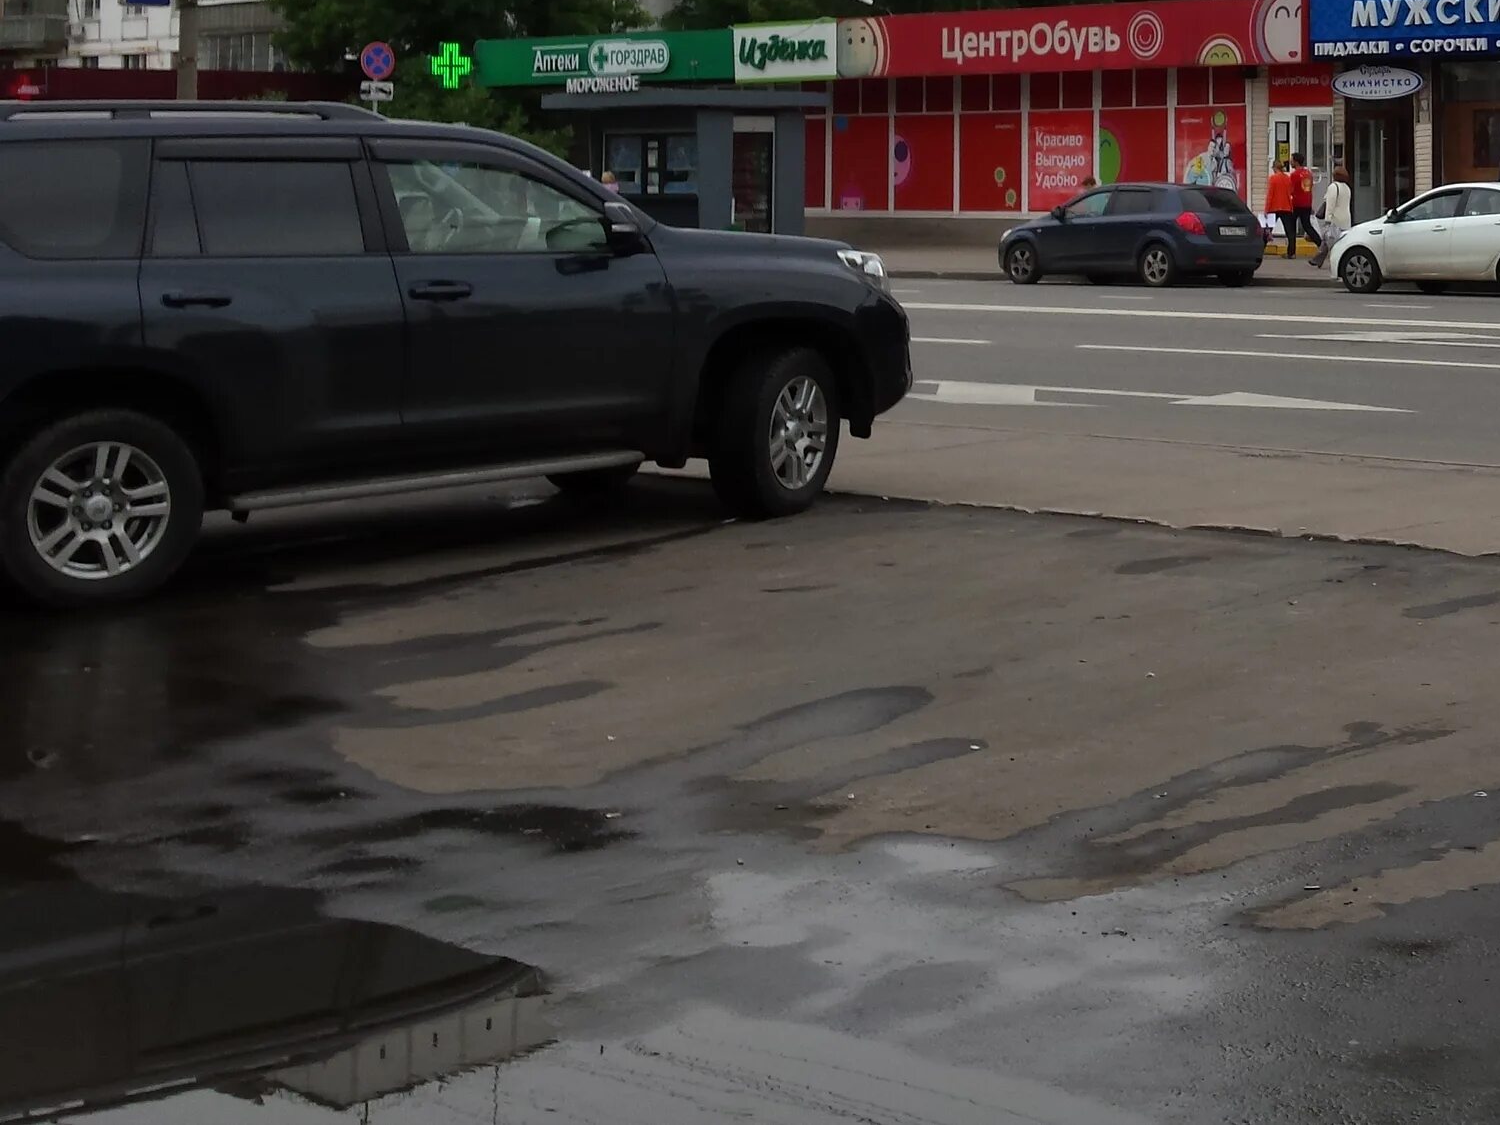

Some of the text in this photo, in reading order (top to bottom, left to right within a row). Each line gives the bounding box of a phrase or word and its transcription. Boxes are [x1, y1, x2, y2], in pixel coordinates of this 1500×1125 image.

[941, 20, 1121, 65] ЦентрОбувь
[1314, 40, 1390, 57] ПИДЖАКИ
[1409, 37, 1488, 53] СОРОЧКИ
[534, 48, 665, 72] Аптеки ГОРЗДРАВ
[566, 76, 640, 94] МОРОЖЕНОЕ
[1036, 131, 1083, 150] Красиво
[1036, 152, 1085, 168] Выгодно
[1036, 172, 1077, 188] Удобно
